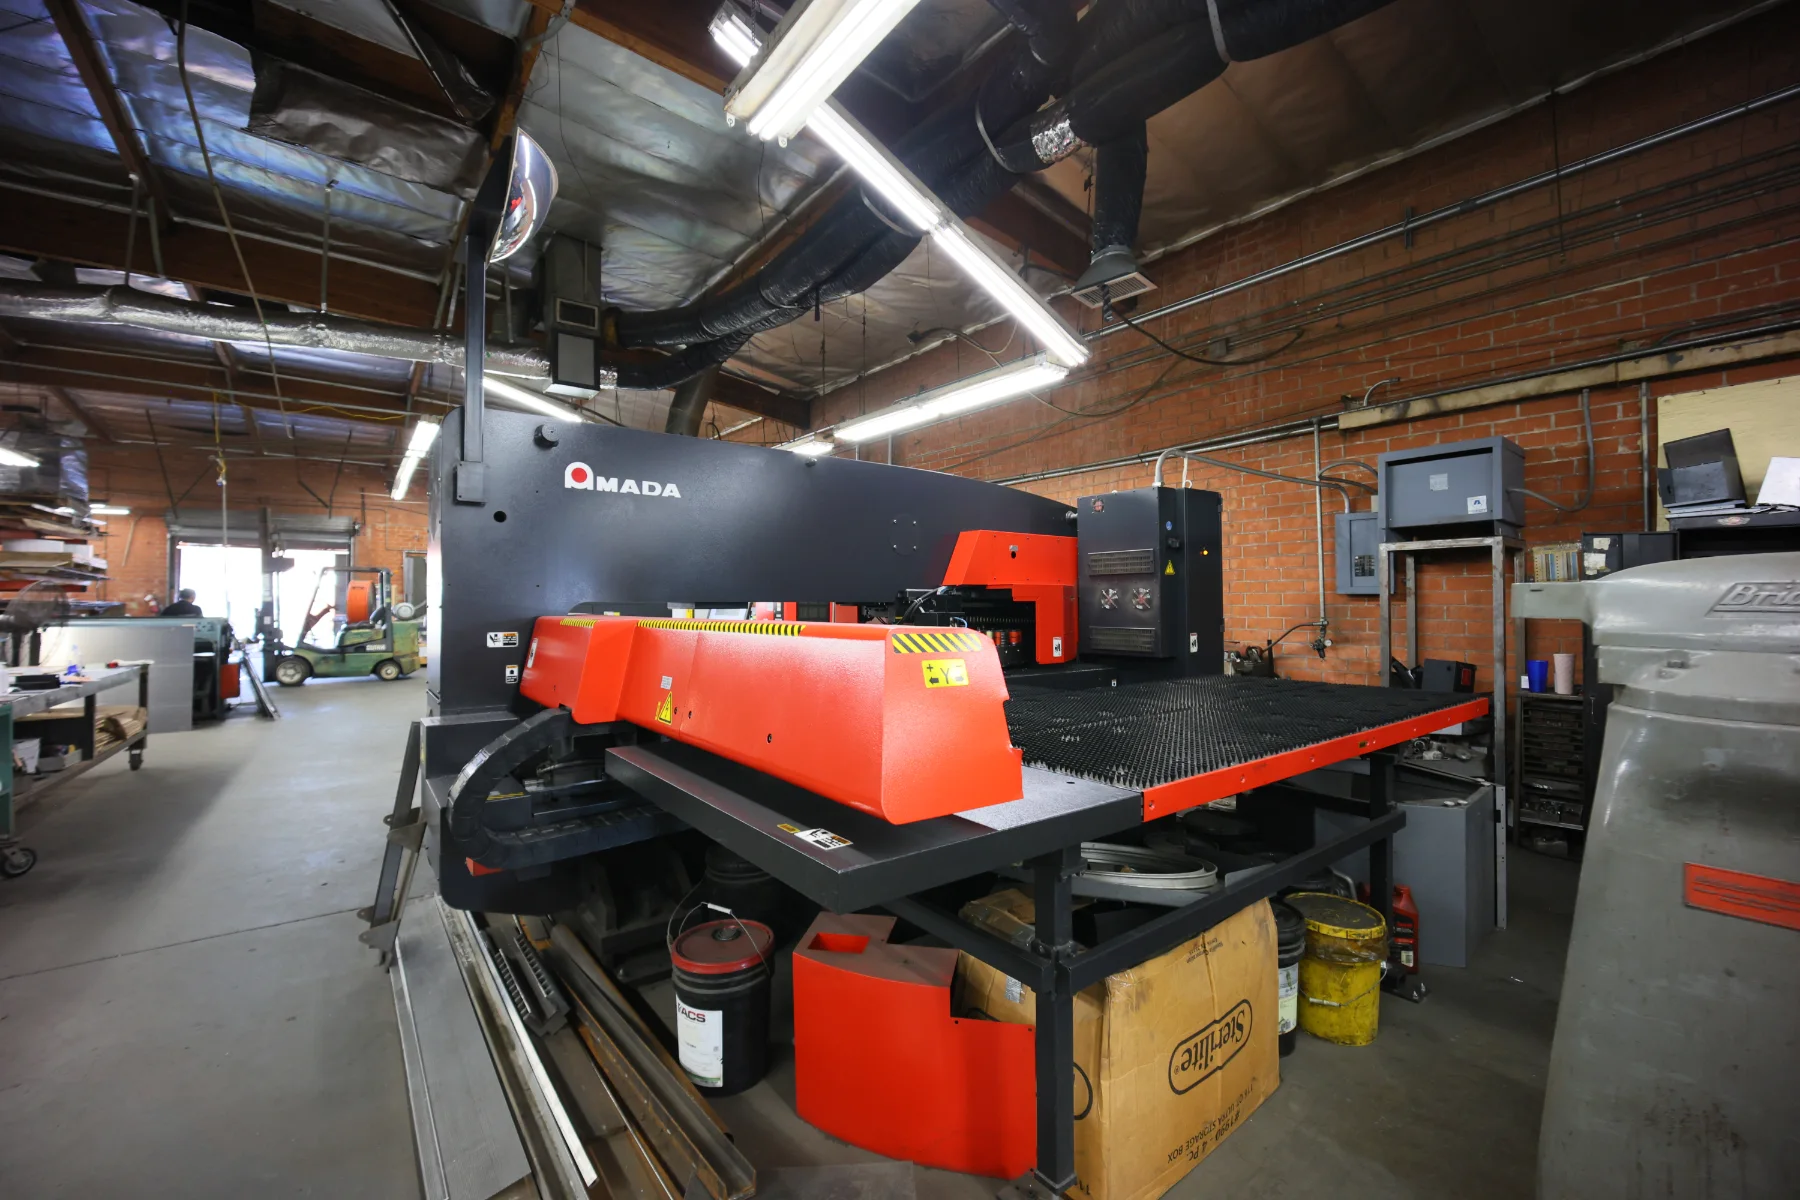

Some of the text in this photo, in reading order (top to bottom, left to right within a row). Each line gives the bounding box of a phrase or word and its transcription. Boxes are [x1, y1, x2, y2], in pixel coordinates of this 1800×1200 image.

[564, 461, 682, 499] AMADA
[1180, 1008, 1246, 1073] Sterilite
[1185, 1120, 1217, 1152] STORAGE
[1167, 1144, 1184, 1164] BOX
